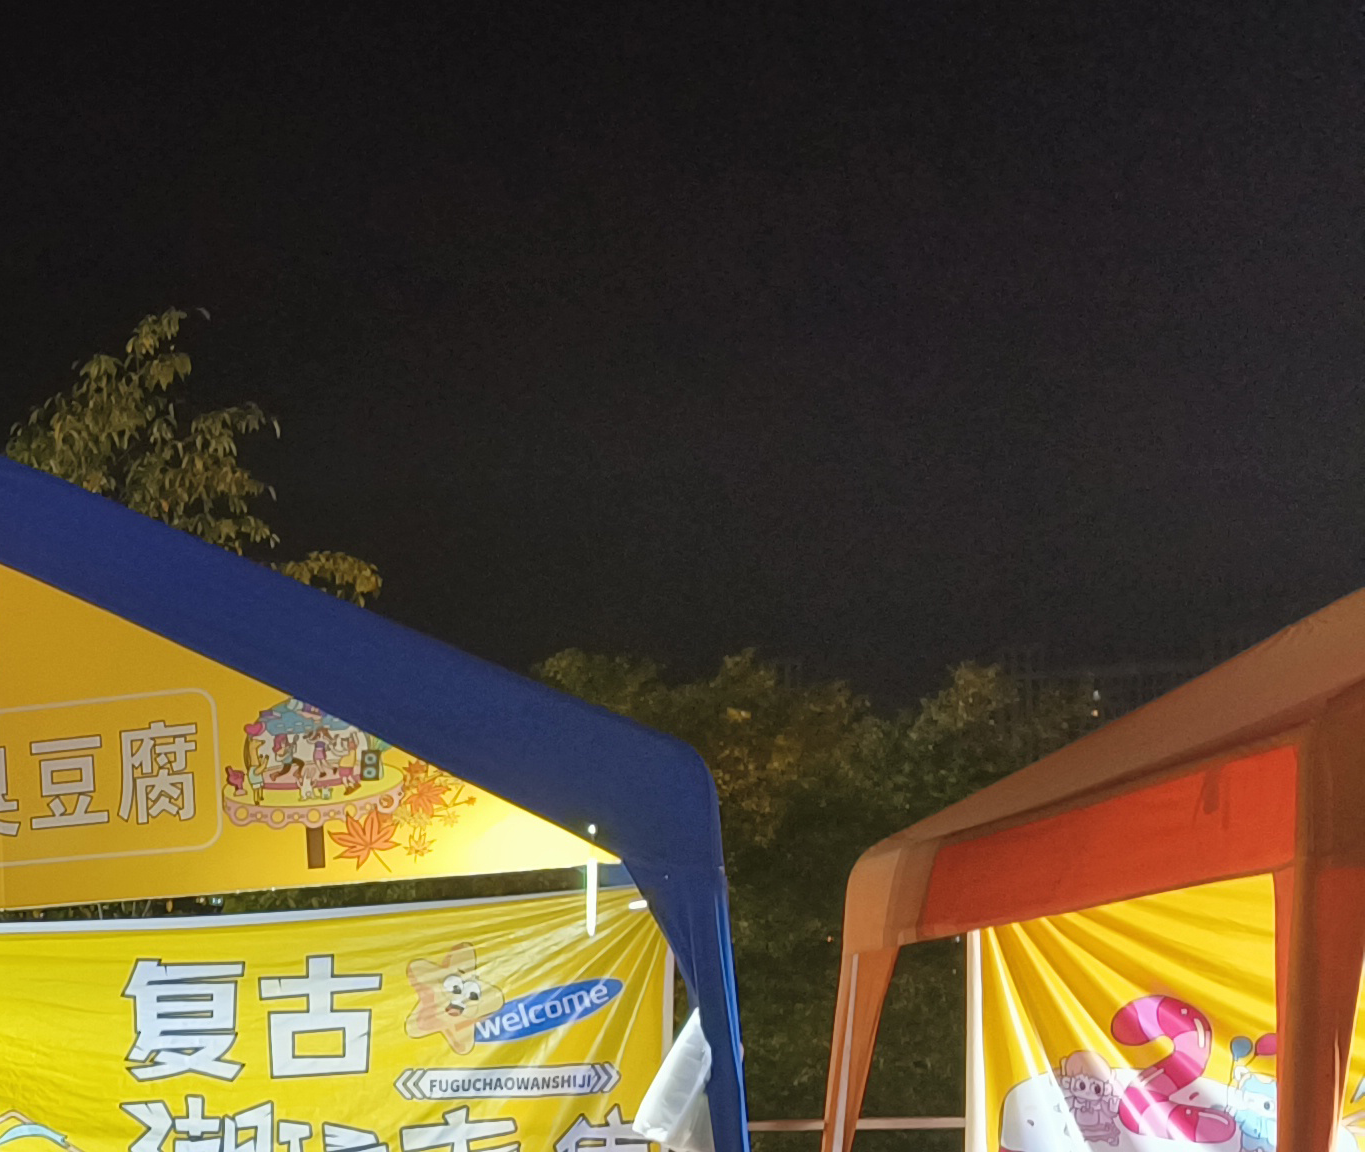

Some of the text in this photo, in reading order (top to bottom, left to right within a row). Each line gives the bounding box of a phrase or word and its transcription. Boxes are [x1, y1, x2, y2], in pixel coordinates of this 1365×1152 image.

[121, 954, 382, 1083] 复古
[475, 977, 610, 1041] welcome
[428, 1072, 593, 1096] FUGUCHAOWANSHIJI
